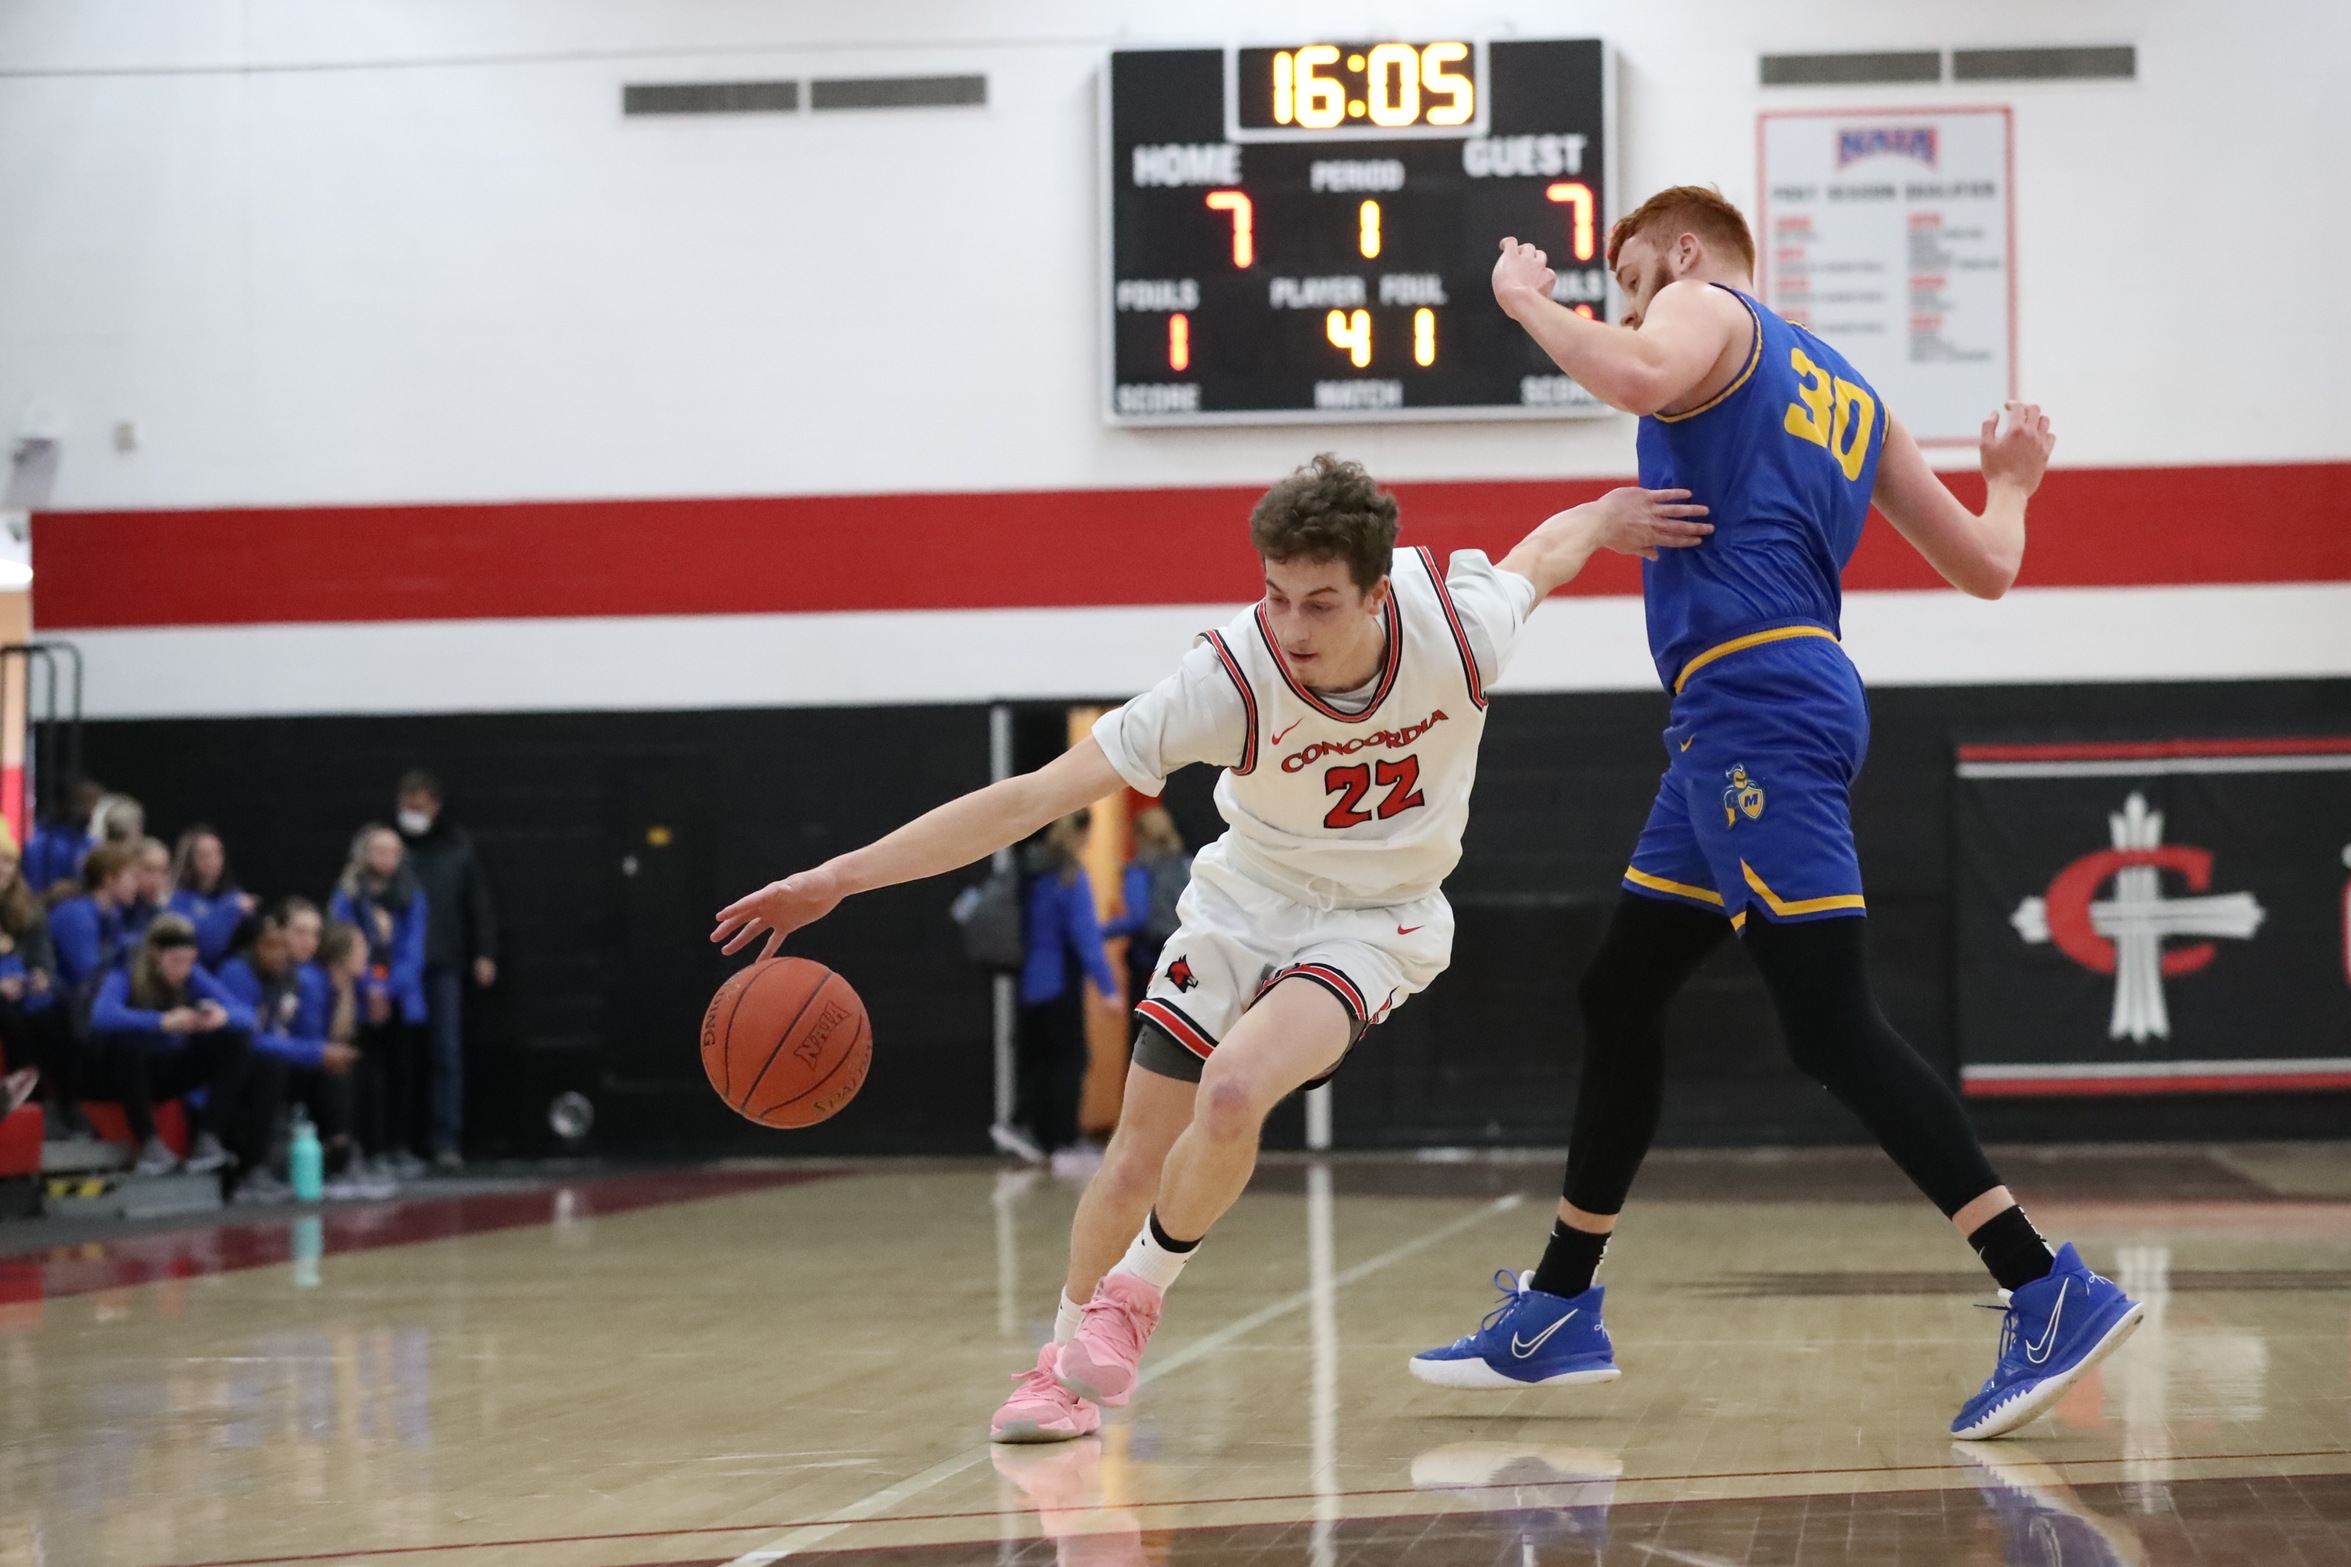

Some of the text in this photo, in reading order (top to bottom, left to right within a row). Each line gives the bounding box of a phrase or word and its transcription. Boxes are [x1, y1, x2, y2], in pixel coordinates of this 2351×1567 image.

[1273, 42, 1474, 128] 16:05
[1133, 143, 1242, 188] HOME
[1310, 160, 1405, 192] PERIOD
[1462, 134, 1587, 178] GUEST
[1206, 191, 1253, 268] 7
[1360, 200, 1380, 259] 1
[1546, 183, 1593, 261] 7
[1117, 278, 1199, 311] FOULS
[1269, 273, 1448, 309] PLAYER FOUL
[1169, 313, 1189, 371] 1
[1326, 308, 1436, 368] 4 1
[1783, 348, 1875, 481] 30
[1281, 709, 1449, 773] CONCORDIA
[1323, 754, 1425, 829] 22
[1744, 794, 1758, 807] M
[794, 1000, 852, 1071] NAIA
